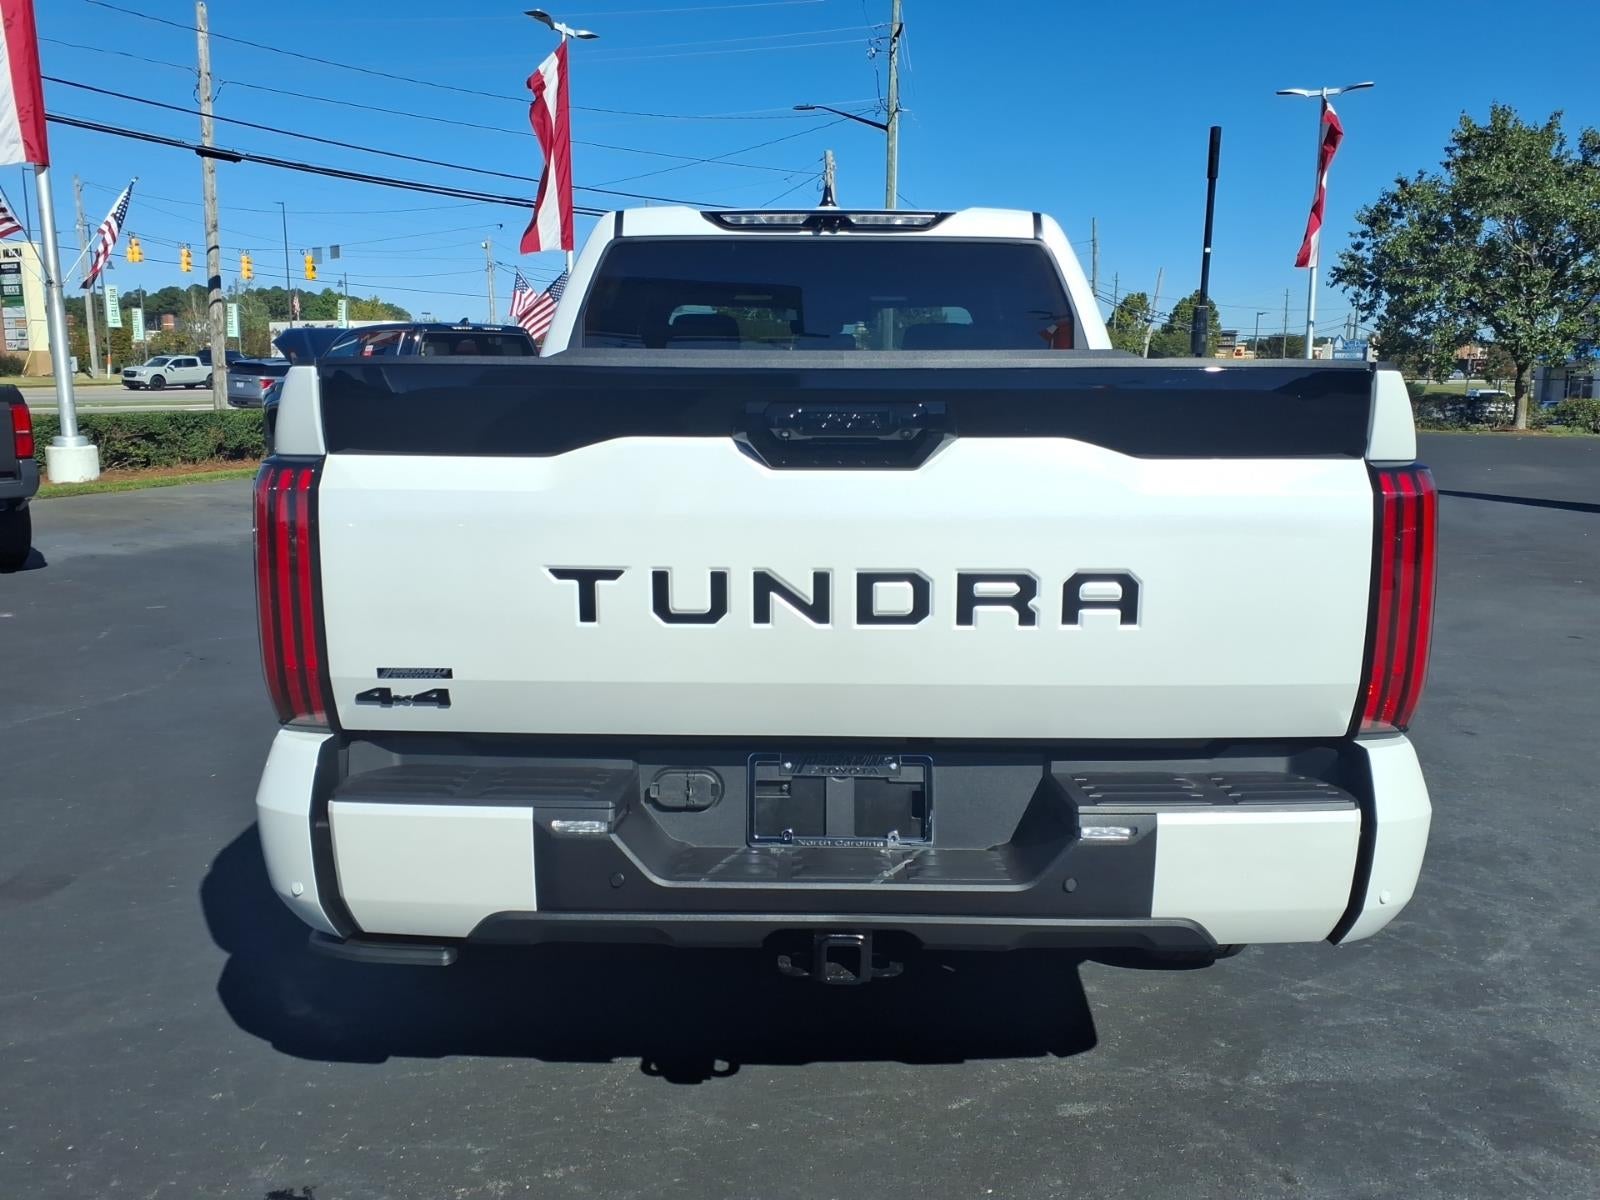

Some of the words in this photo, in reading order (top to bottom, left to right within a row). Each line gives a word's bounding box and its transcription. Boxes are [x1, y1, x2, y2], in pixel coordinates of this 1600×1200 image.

[544, 567, 1141, 628] TUNDRA
[355, 687, 451, 708] 4x4
[819, 767, 880, 775] TOYOTA
[798, 839, 831, 847] North
[834, 839, 884, 847] Carolina
